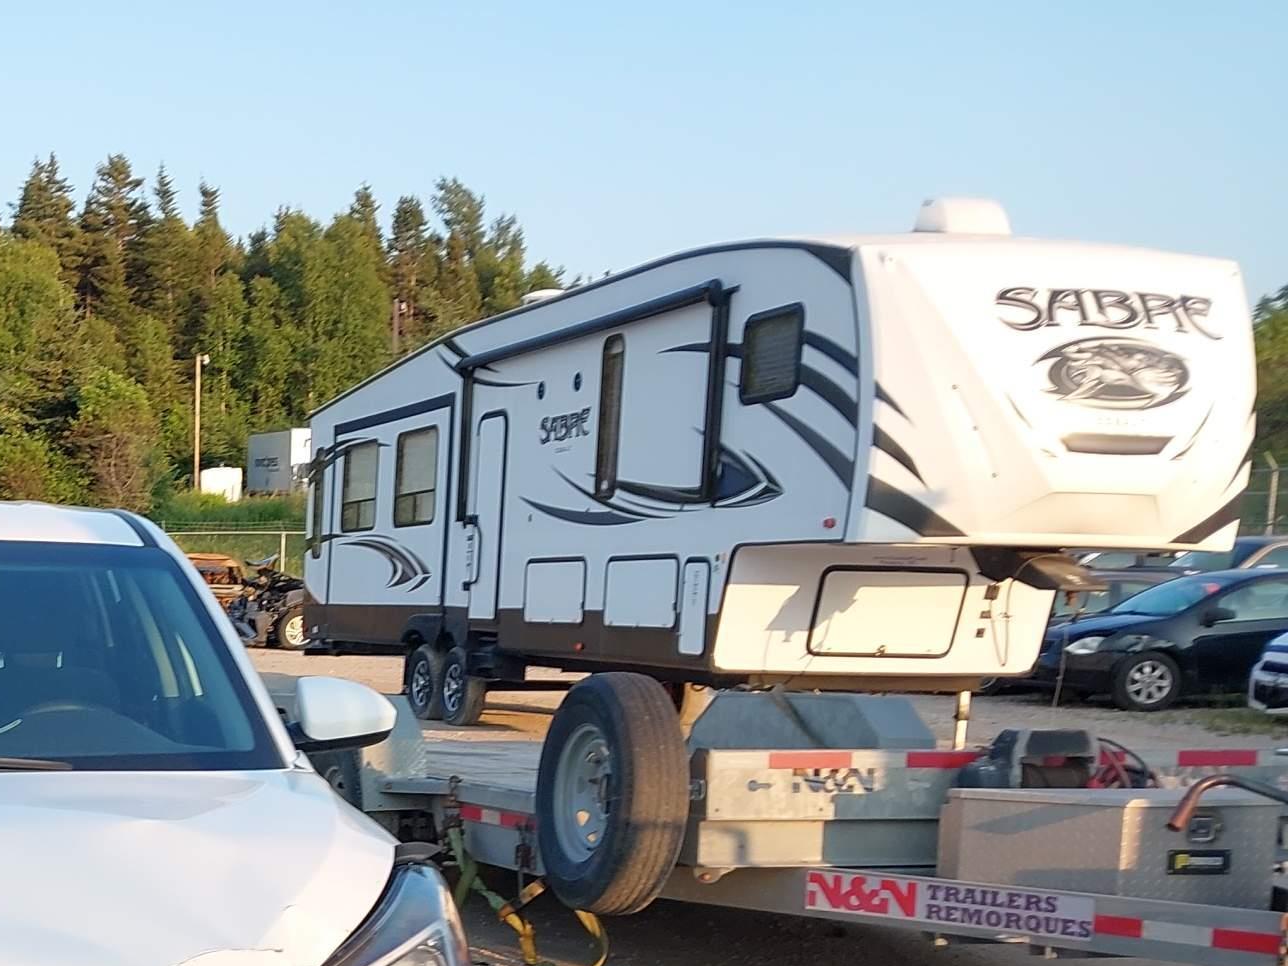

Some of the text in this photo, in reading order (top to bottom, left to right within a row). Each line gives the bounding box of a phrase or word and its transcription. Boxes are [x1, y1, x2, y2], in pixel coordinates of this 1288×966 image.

[994, 287, 1224, 341] SABRE
[808, 871, 1058, 918] N&N TRAILERS
[925, 903, 1093, 939] REMORQUES
